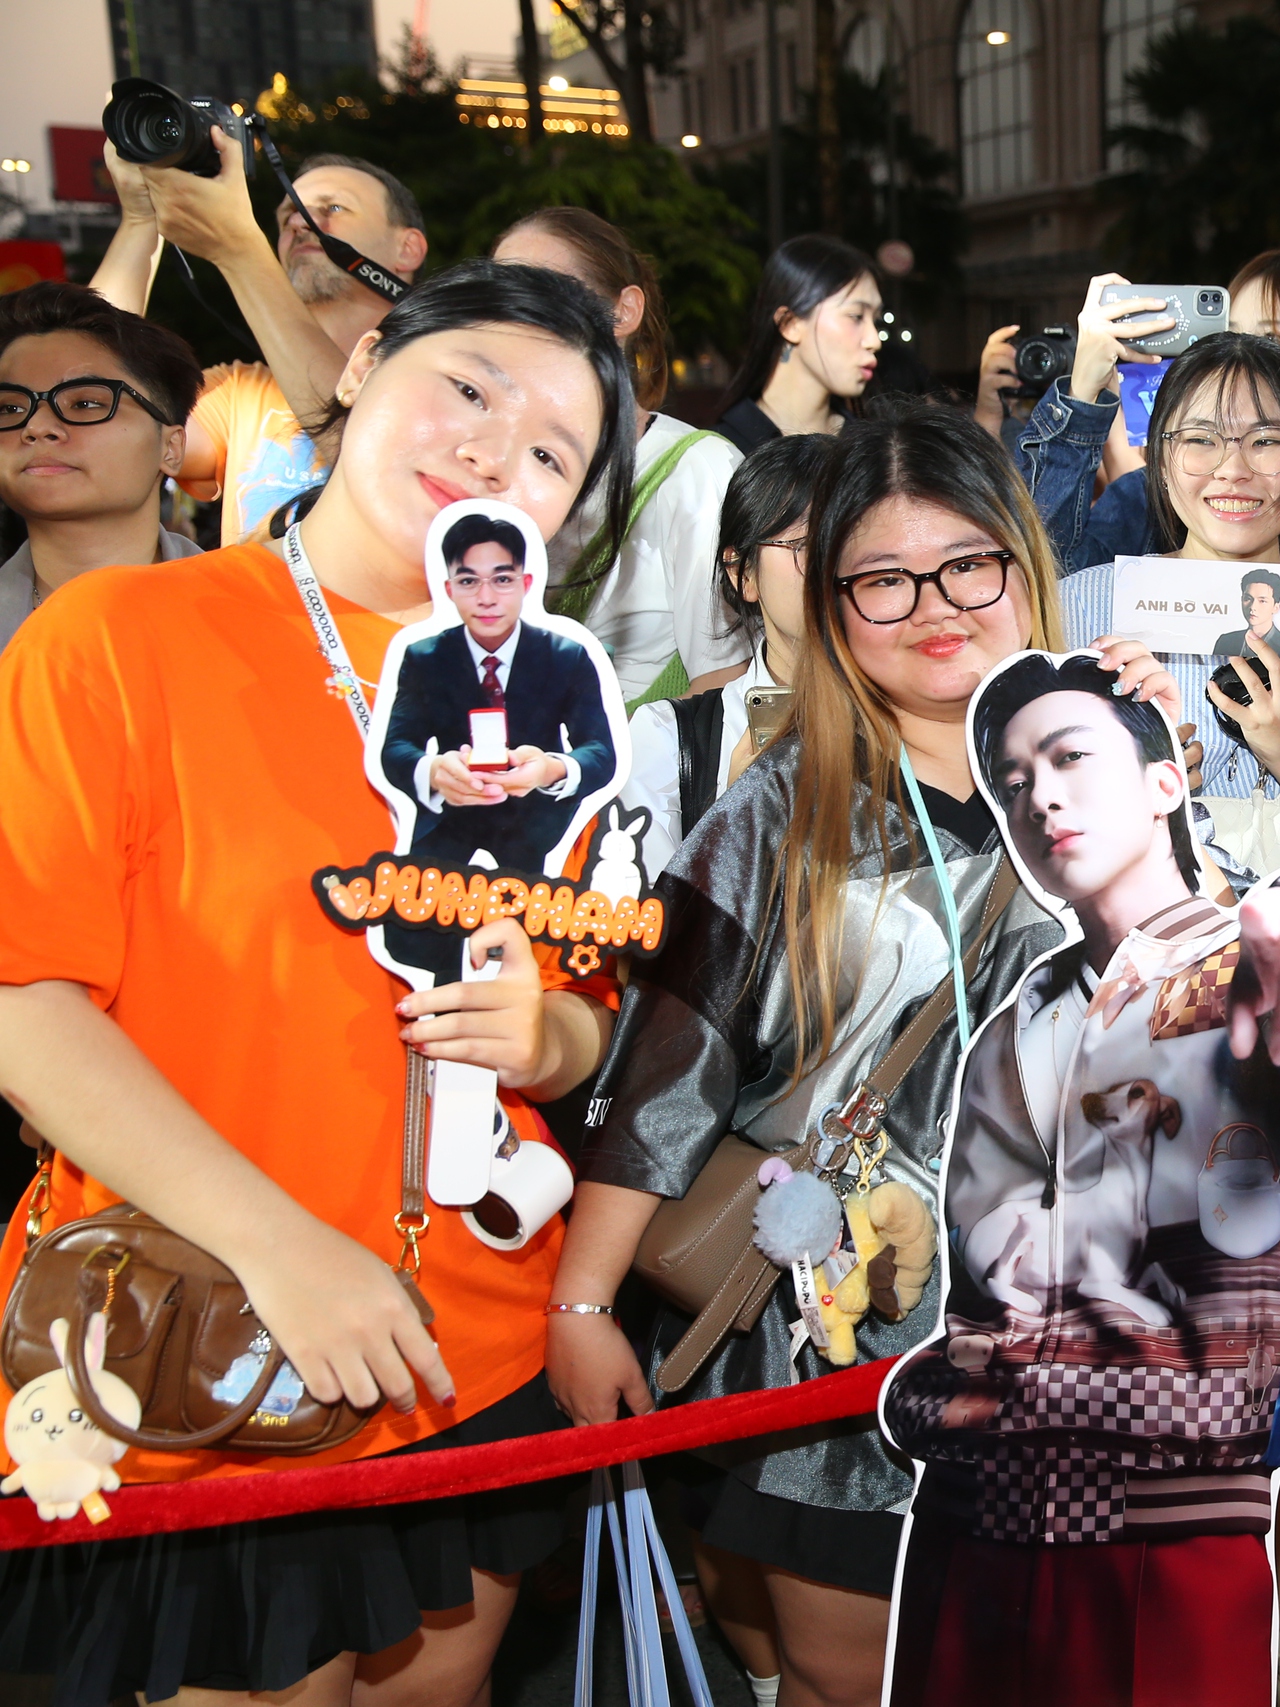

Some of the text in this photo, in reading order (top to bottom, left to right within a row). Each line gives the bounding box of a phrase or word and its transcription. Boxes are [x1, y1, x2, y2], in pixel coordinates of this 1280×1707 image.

[358, 263, 404, 297] SONY
[1134, 599, 1168, 612] ANH
[1203, 603, 1228, 615] VAI
